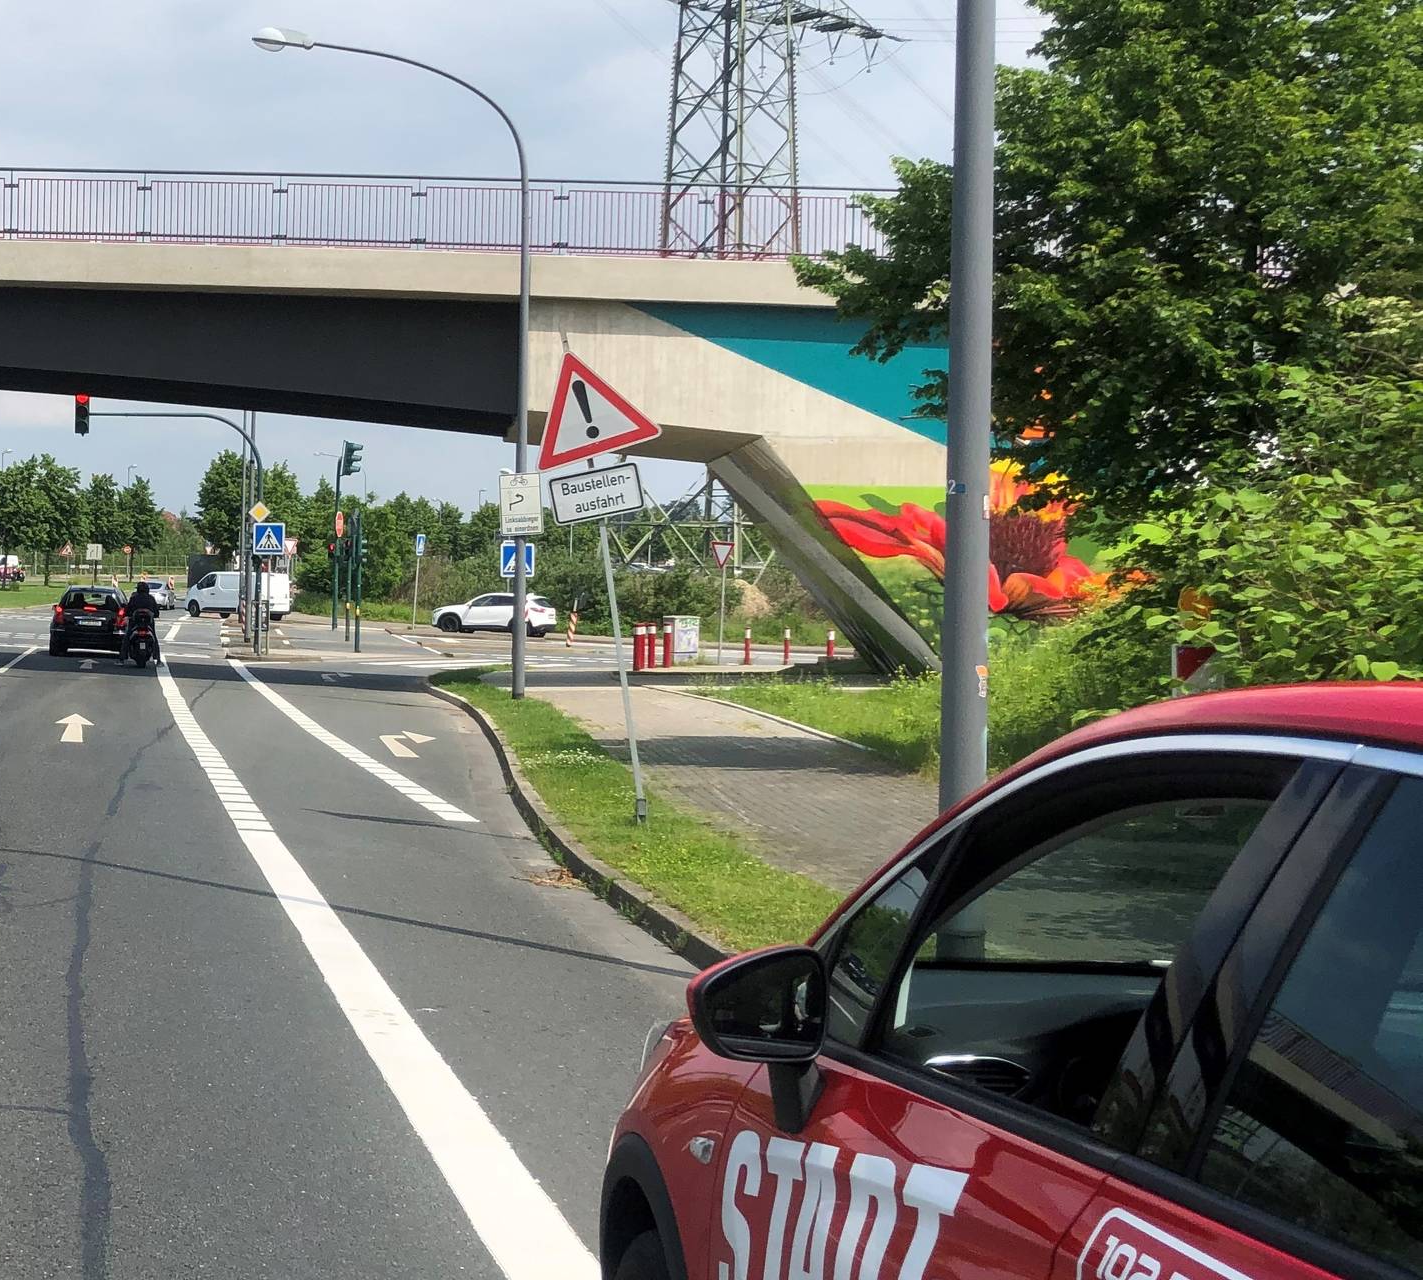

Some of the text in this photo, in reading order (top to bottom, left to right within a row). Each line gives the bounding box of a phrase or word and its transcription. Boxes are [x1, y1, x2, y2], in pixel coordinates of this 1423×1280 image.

[561, 474, 631, 496] Baustellen-
[575, 493, 626, 513] ausfahrt
[719, 1130, 970, 1280] STADT
